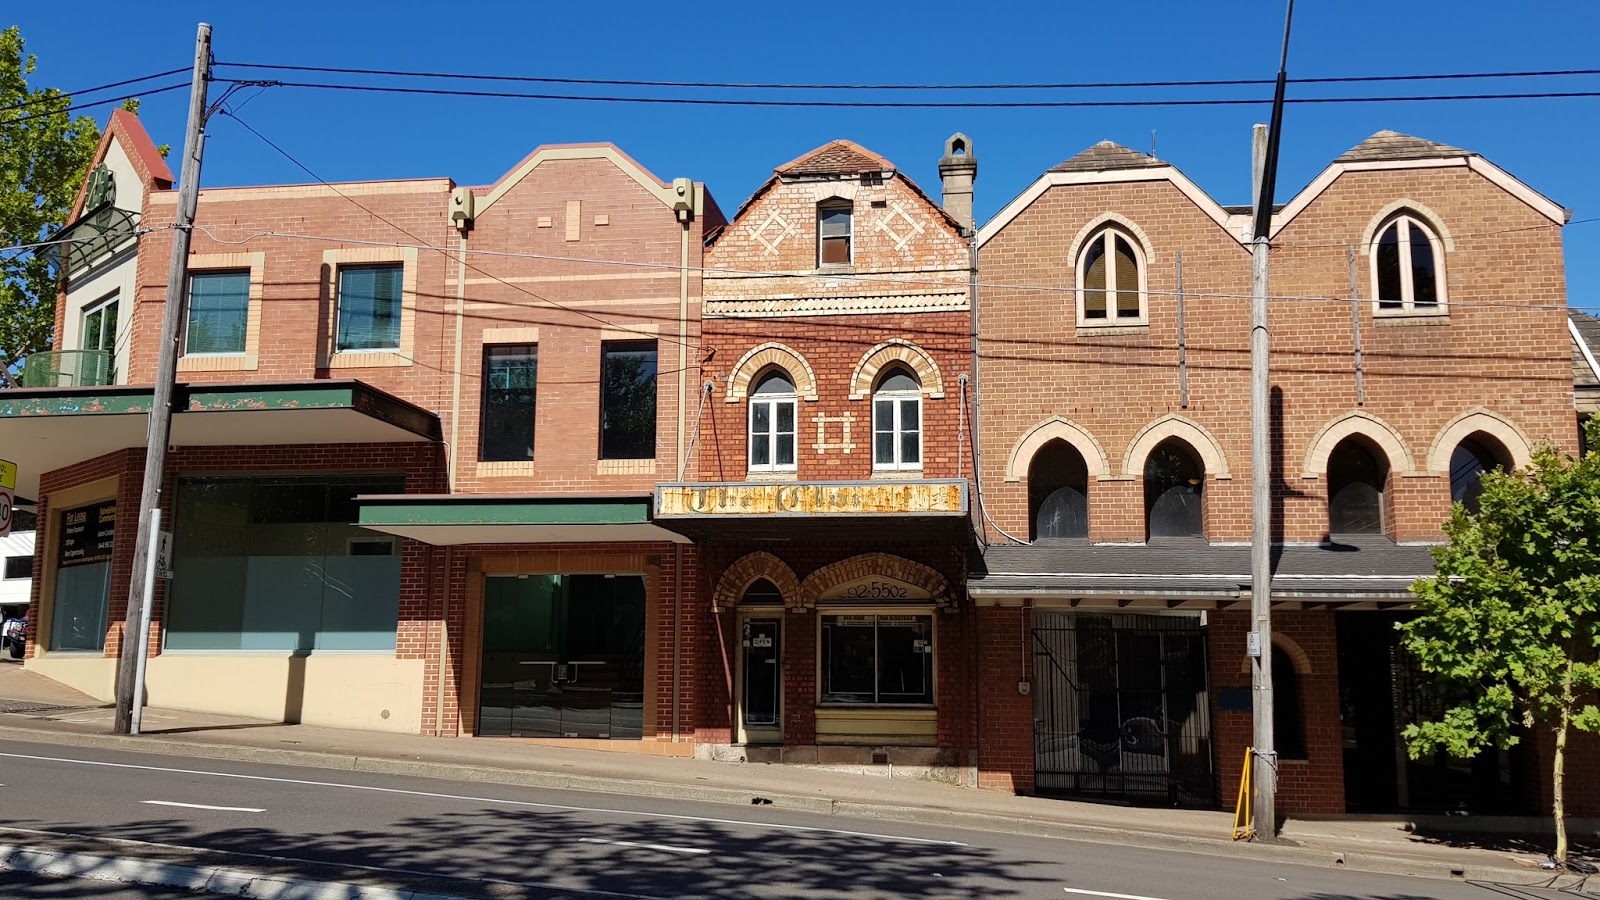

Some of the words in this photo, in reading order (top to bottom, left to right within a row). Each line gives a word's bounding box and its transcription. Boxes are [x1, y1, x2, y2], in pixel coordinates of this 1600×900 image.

[686, 486, 755, 514] The
[66, 513, 75, 523] For
[75, 511, 87, 522] Lease
